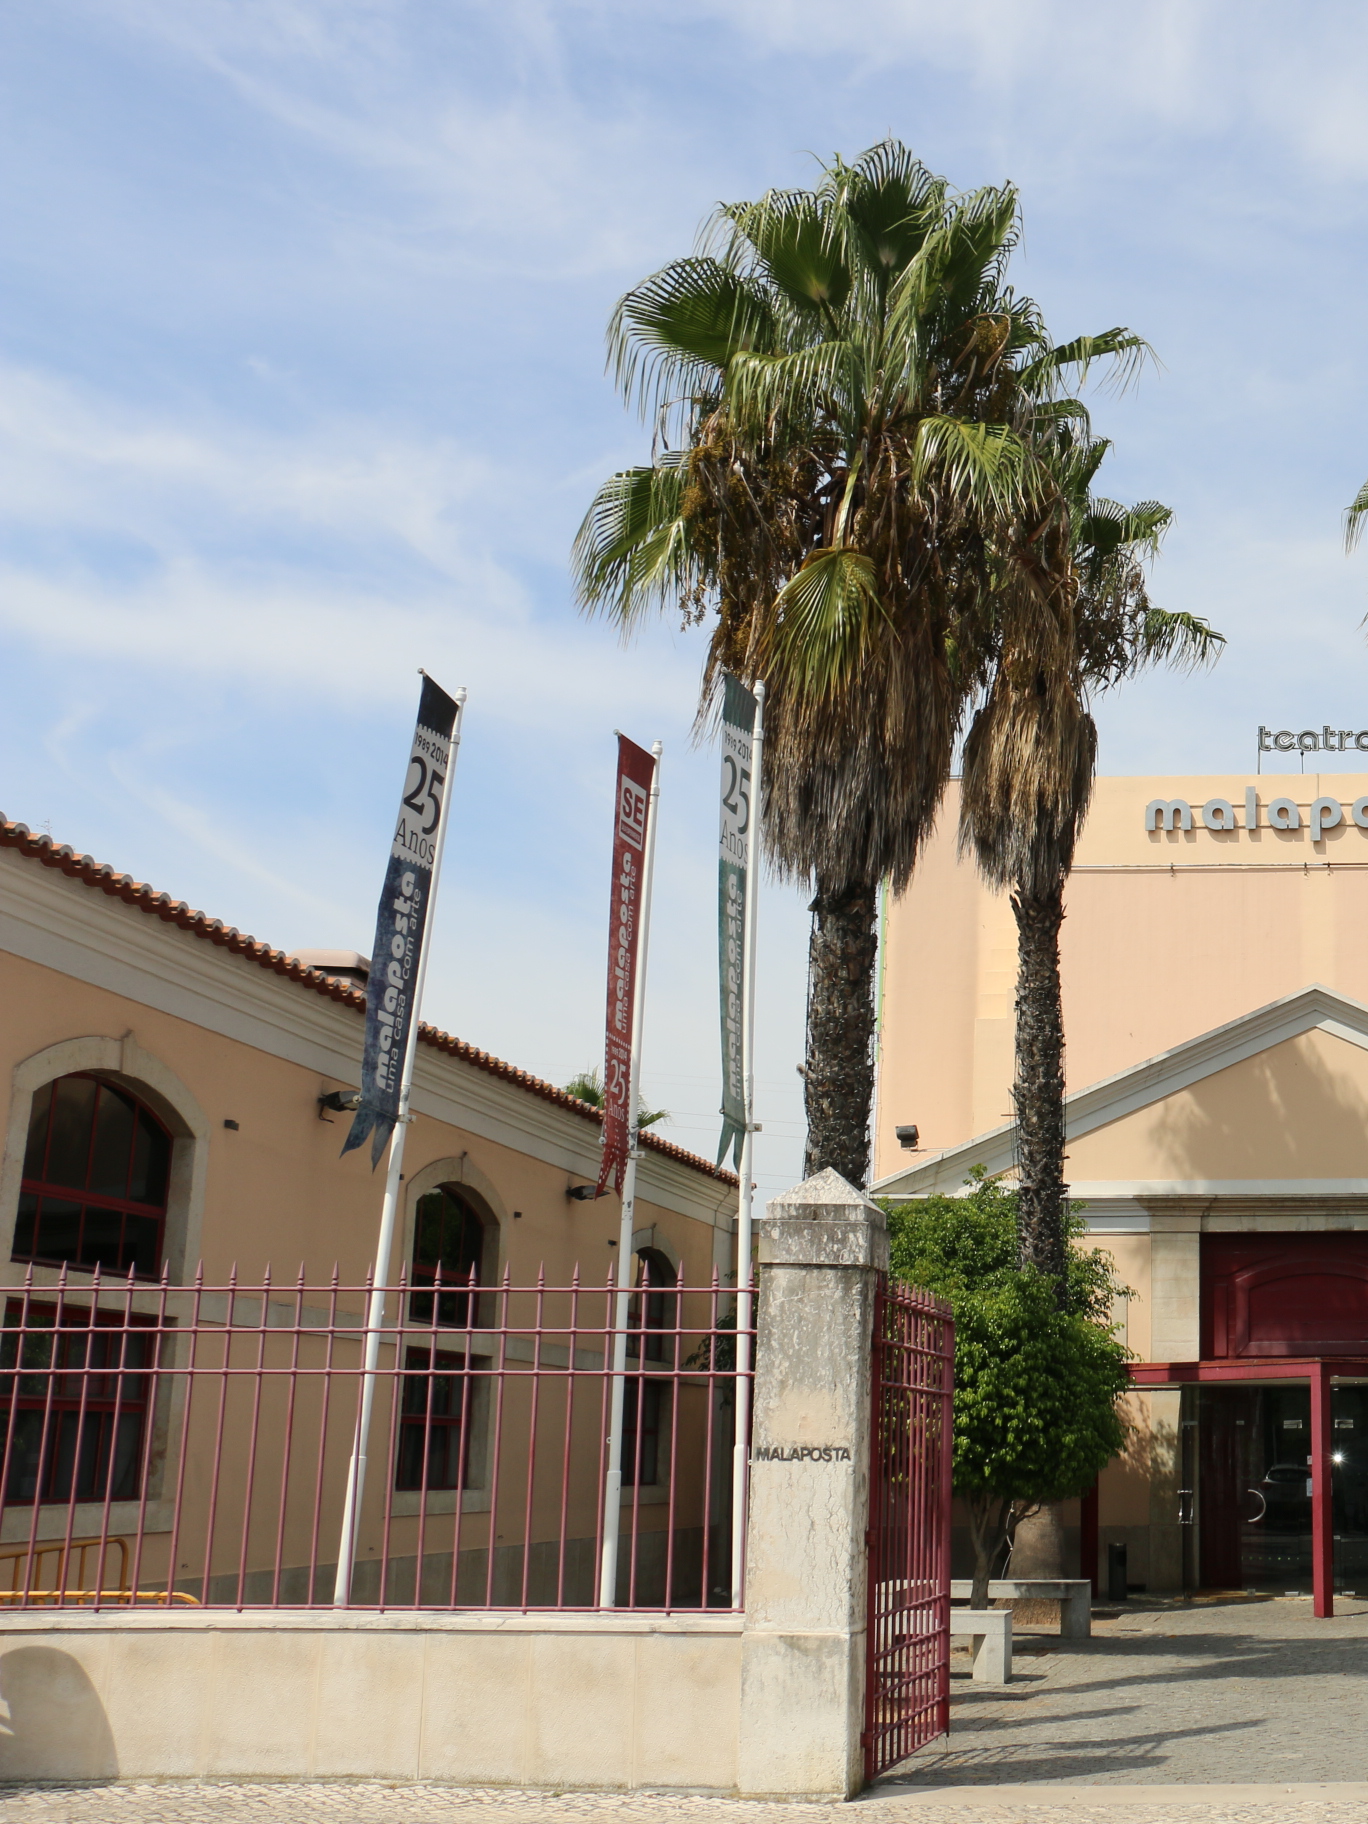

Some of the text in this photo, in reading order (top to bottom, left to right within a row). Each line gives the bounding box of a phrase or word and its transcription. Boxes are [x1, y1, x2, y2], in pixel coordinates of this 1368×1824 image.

[414, 732, 449, 770] 1989 2014
[403, 755, 446, 836] 25
[622, 786, 644, 828] SE
[722, 754, 751, 835] 25
[393, 817, 436, 865] Anos
[719, 819, 749, 865] Anos
[614, 852, 633, 1031] malaposta
[375, 871, 416, 1090] malaposta
[386, 888, 421, 1093] uma casa com arte
[726, 873, 738, 1098] malaposta
[610, 1058, 627, 1105] 25
[756, 1446, 852, 1462] MALAPOSTA
